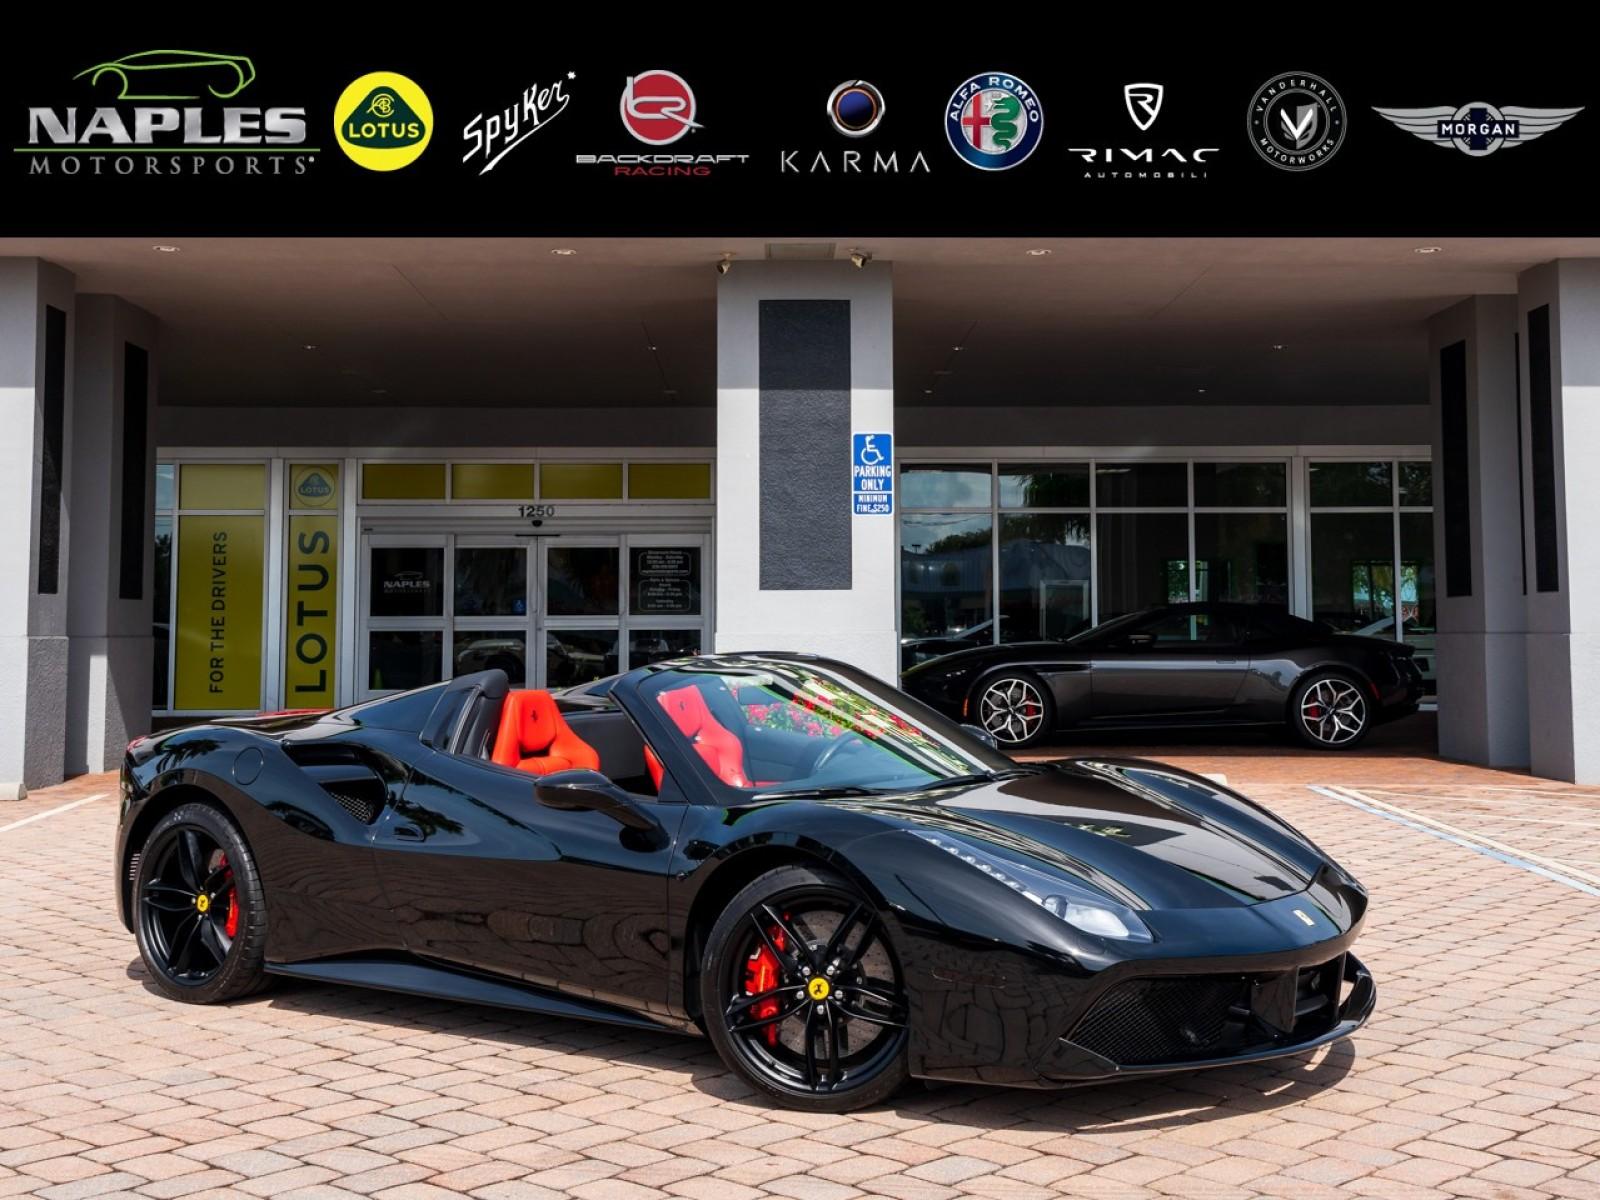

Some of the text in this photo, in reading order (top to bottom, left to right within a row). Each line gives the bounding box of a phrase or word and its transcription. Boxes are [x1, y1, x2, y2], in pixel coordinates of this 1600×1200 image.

[854, 465, 891, 478] PARKING
[300, 486, 330, 495] LOTUS
[861, 479, 884, 491] ONLY
[858, 494, 888, 503] MINIMUM
[518, 505, 554, 517] 1250
[383, 580, 431, 589] NAPLES
[209, 531, 228, 694] FOR THE DRIVERS
[295, 530, 330, 693] LOTUS
